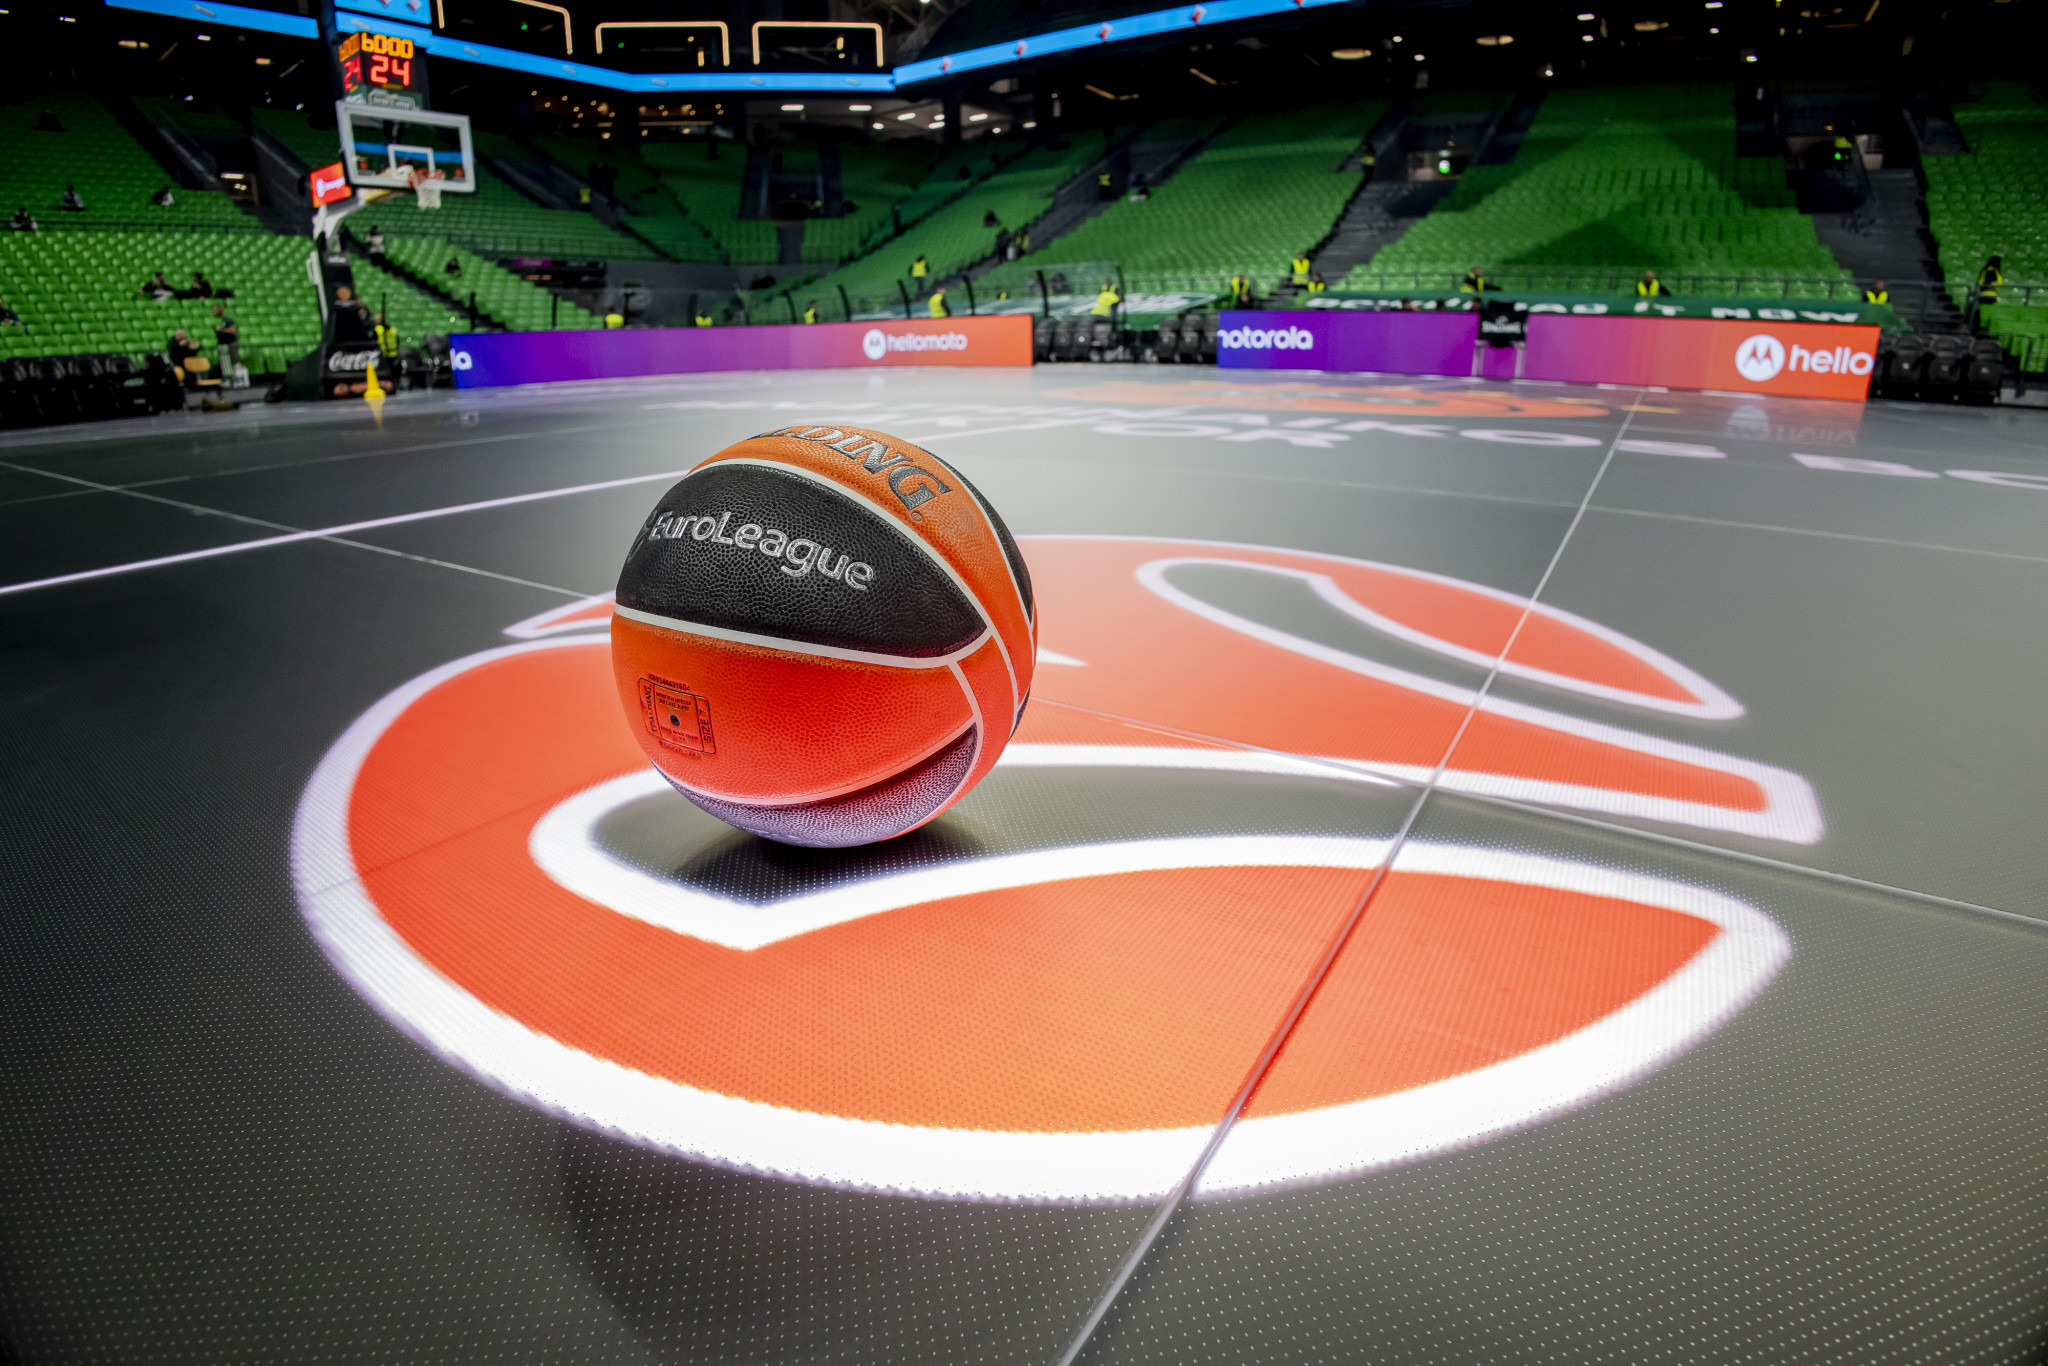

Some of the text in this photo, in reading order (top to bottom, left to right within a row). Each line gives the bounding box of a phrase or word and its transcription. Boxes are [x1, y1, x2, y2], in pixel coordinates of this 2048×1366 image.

[370, 54, 410, 87] 24
[887, 332, 968, 351] hellomoto
[1789, 344, 1875, 375] hello
[649, 511, 875, 591] EuroLeague
[700, 718, 712, 742] SIZE
